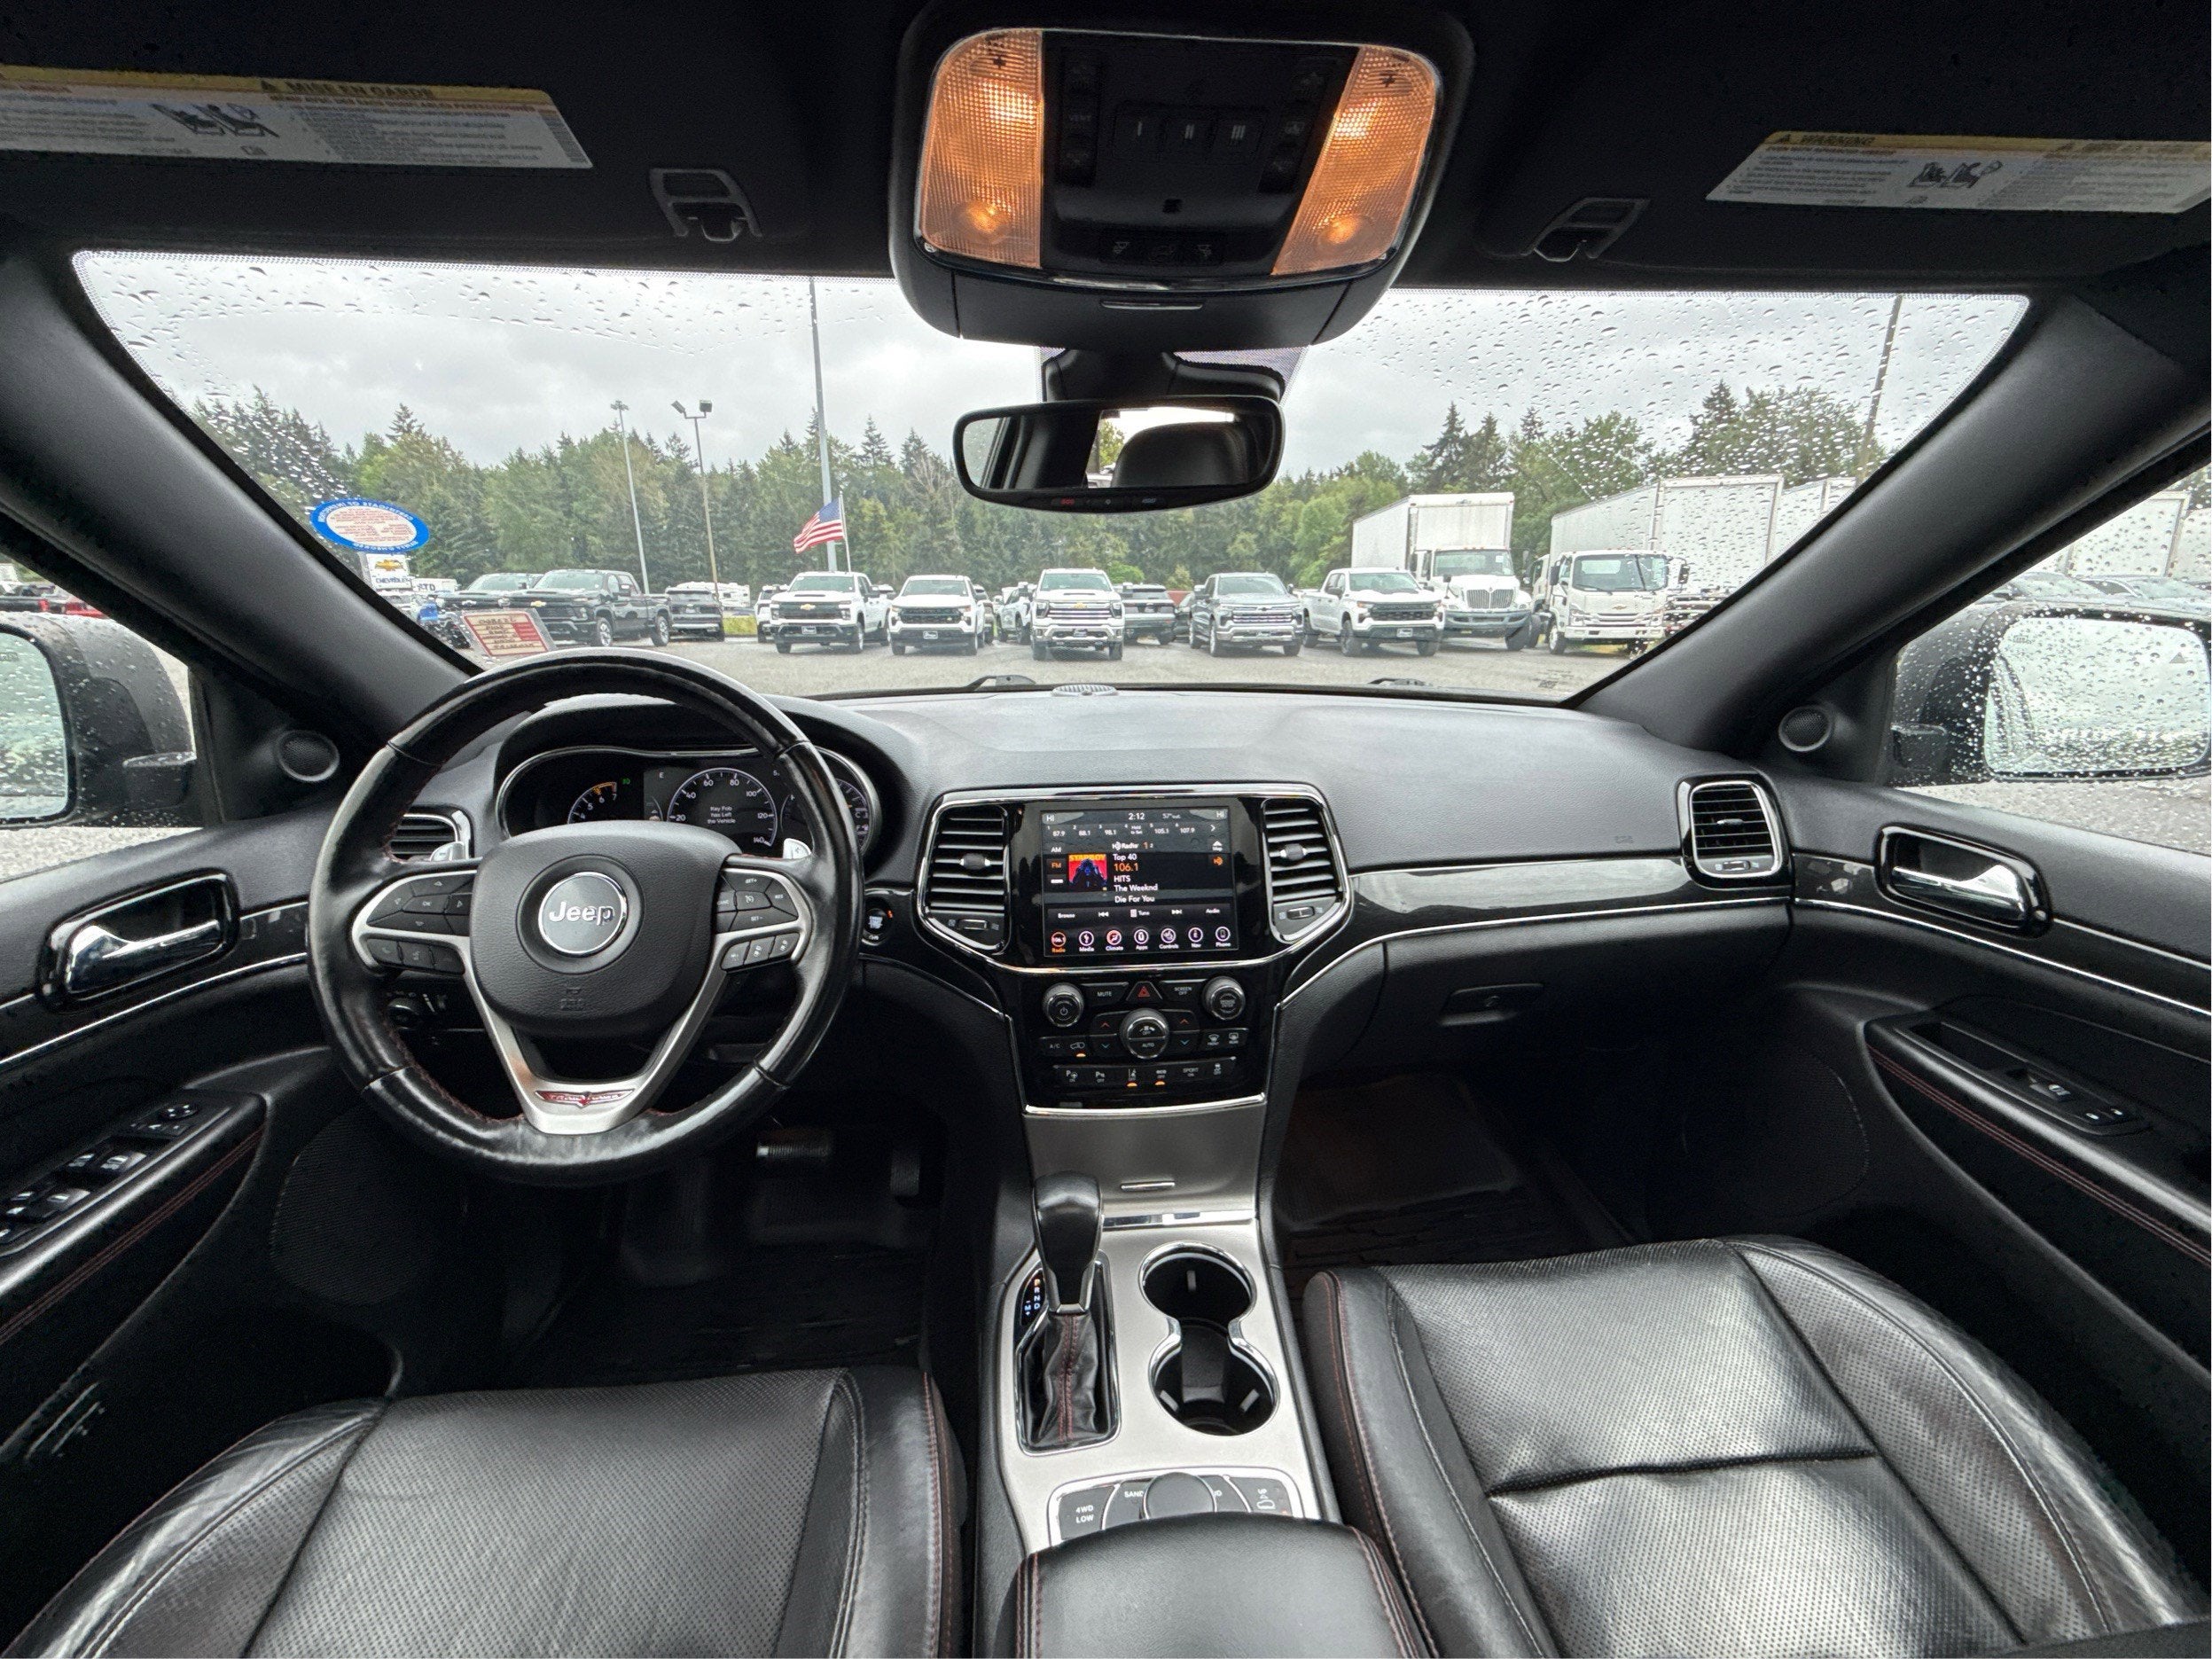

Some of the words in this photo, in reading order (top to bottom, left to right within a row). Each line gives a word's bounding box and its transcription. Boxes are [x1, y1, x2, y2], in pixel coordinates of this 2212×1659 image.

[1128, 812, 1145, 821] 2:12
[1113, 853, 1126, 862] Top
[1114, 862, 1138, 872] 106.1
[1114, 874, 1131, 883] HITS
[1129, 883, 1159, 892] Weeknd
[1114, 895, 1127, 904] Die
[1141, 894, 1155, 903] You
[549, 900, 615, 926] Jeep
[1075, 1504, 1094, 1513] 4WD
[1075, 1514, 1094, 1523] LOW
